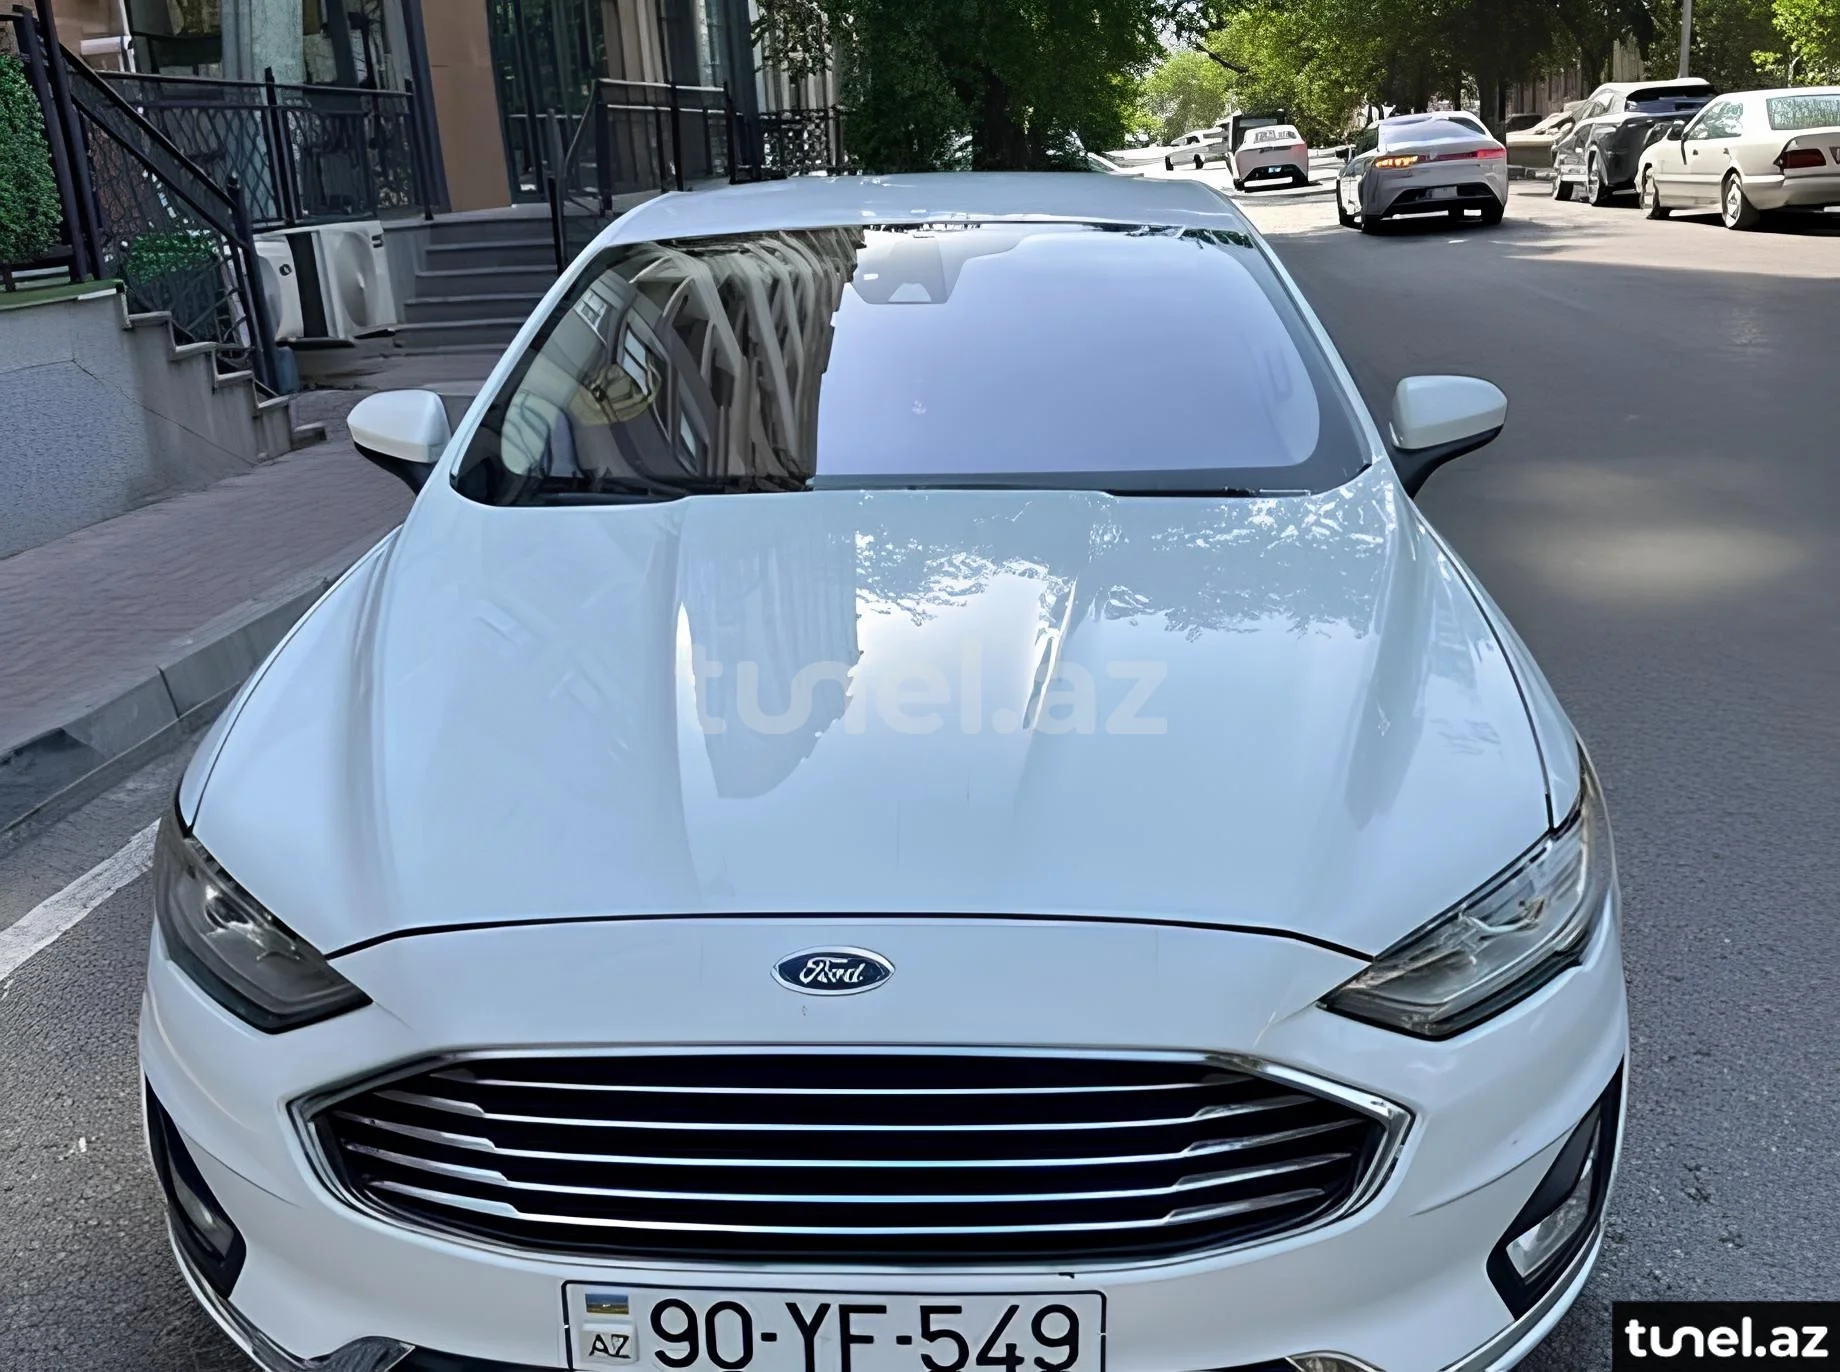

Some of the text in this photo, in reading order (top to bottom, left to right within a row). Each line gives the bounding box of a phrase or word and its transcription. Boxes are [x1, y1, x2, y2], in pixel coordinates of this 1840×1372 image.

[800, 957, 865, 983] Ford
[588, 1333, 631, 1359] AZ
[650, 1298, 1080, 1372] 90-YF-549
